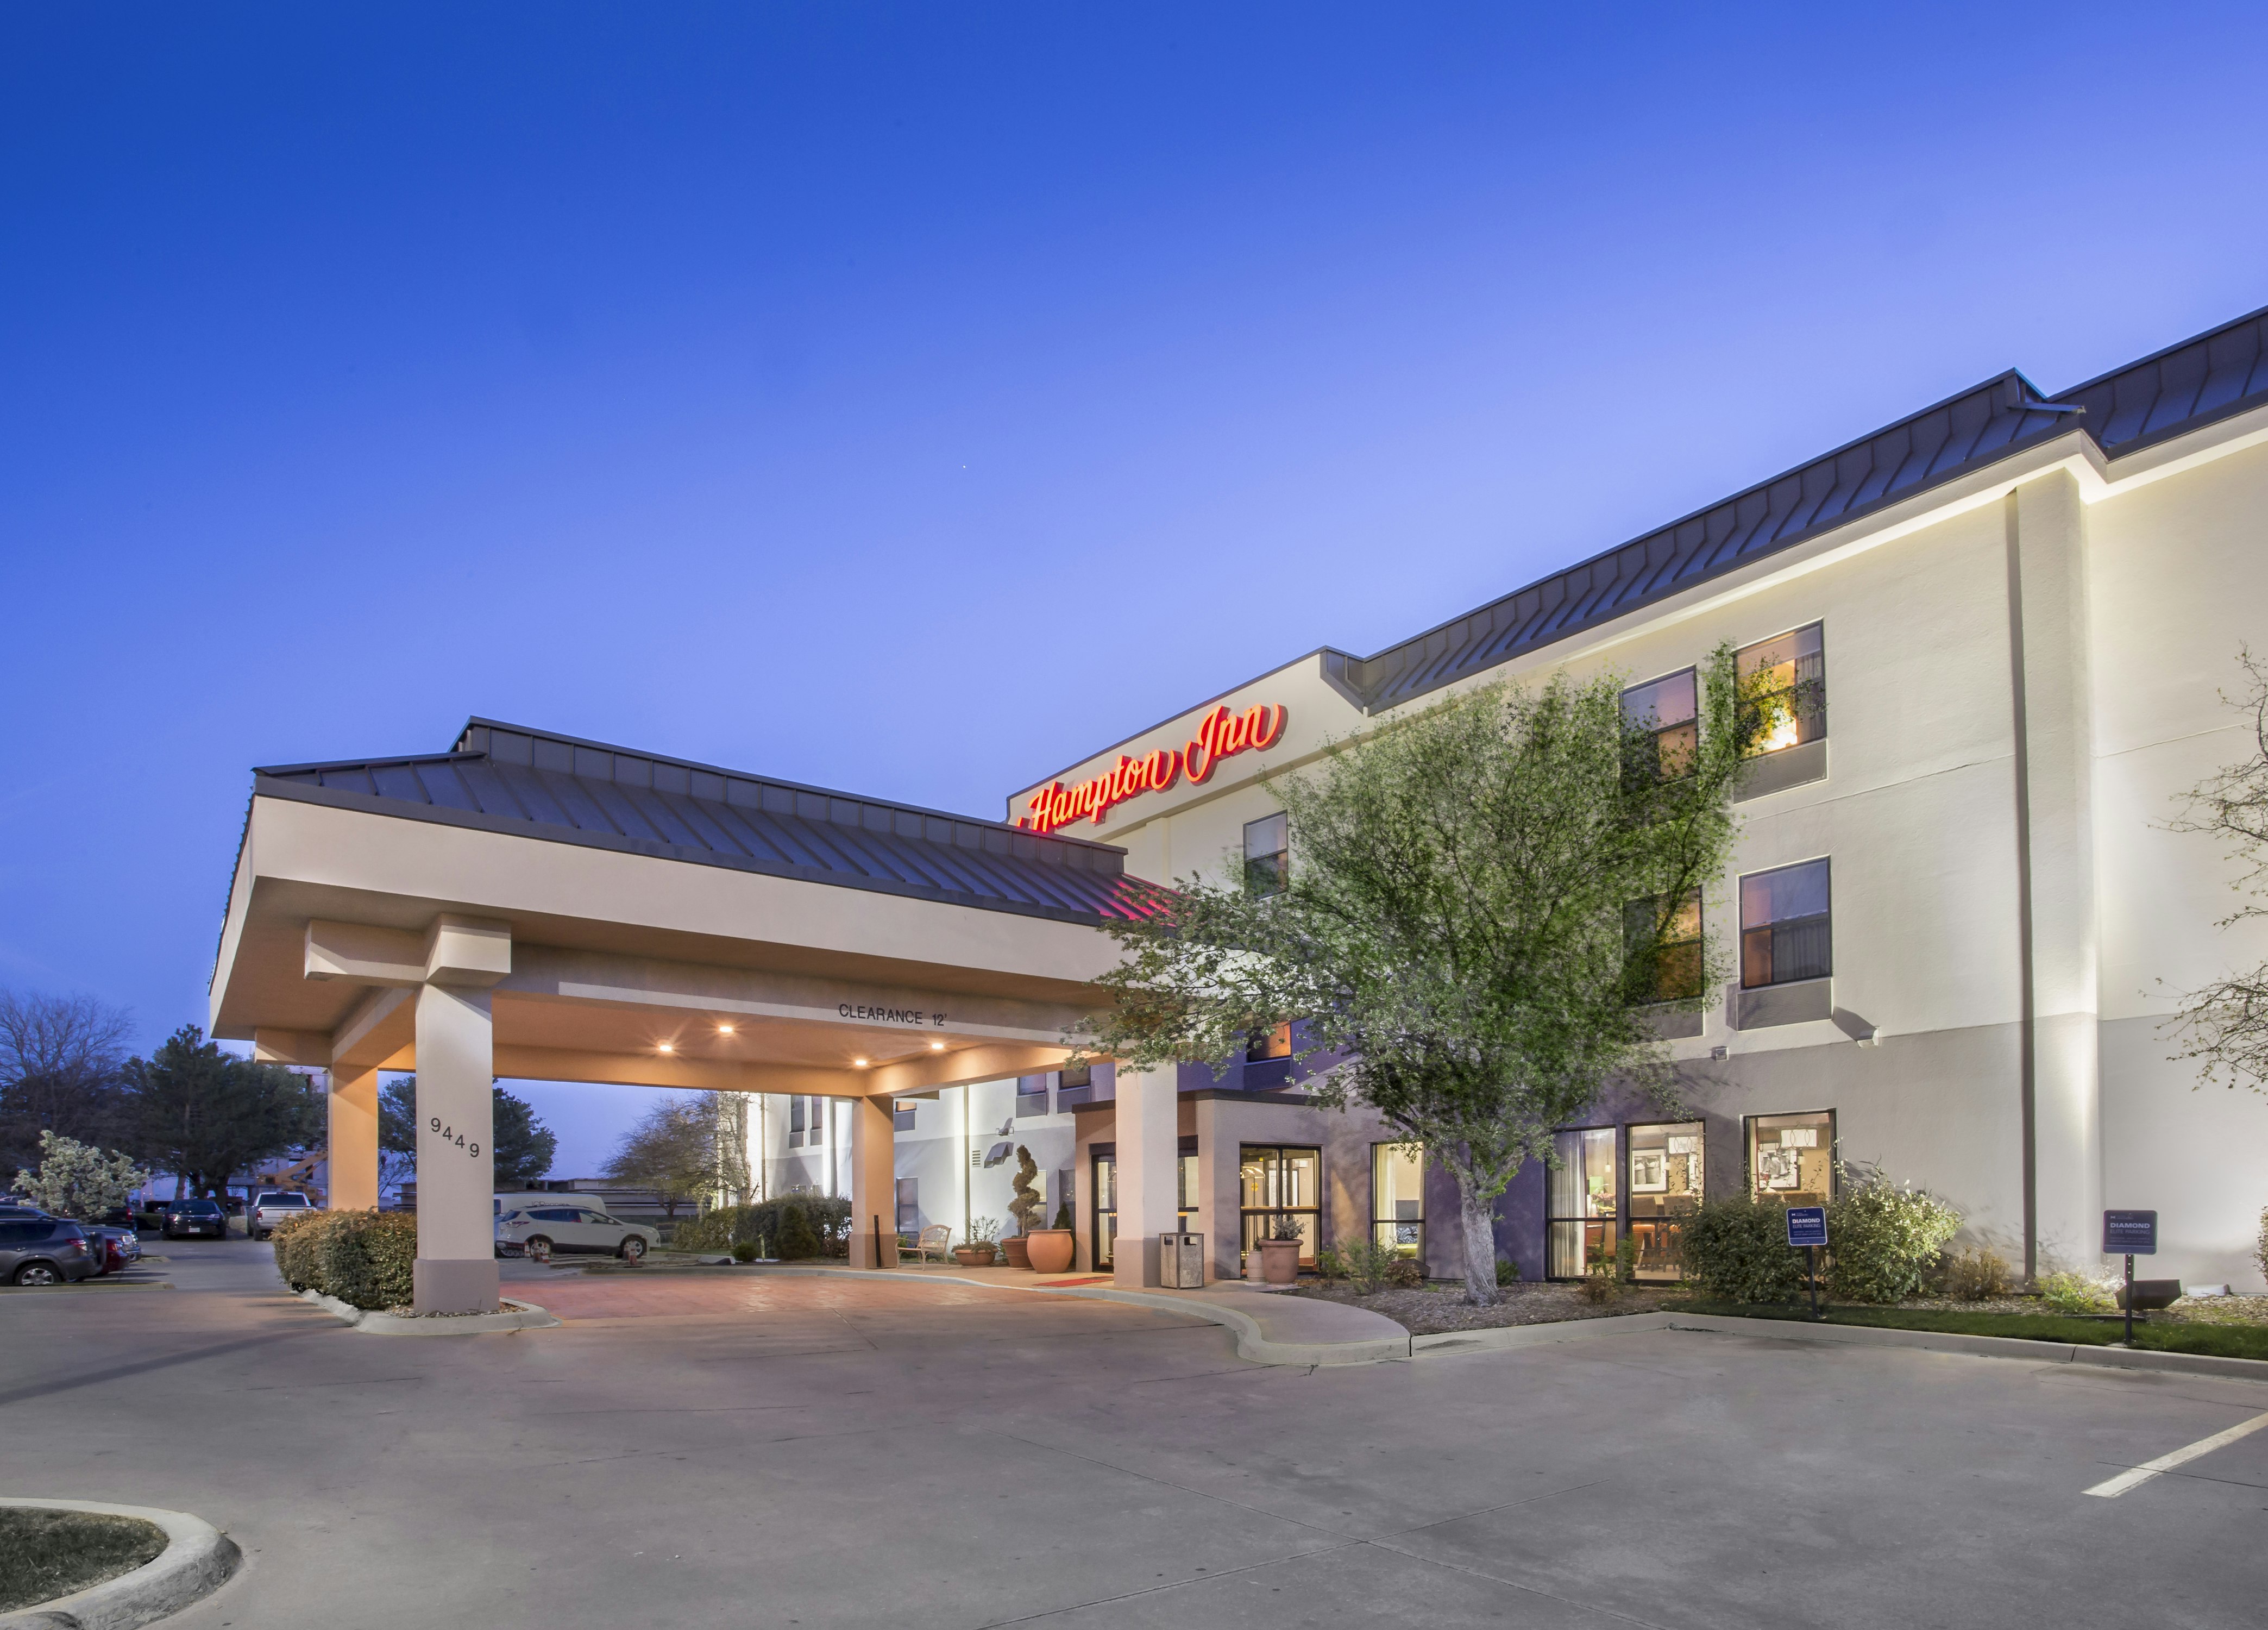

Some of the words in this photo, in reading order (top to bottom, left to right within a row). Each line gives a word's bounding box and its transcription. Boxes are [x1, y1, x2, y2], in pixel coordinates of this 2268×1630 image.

[1017, 749, 1178, 832] Hampton
[1183, 703, 1281, 782] Inn
[838, 1004, 923, 1024] CLEARANCE
[932, 1013, 947, 1026] 12'
[430, 1117, 480, 1158] 9449
